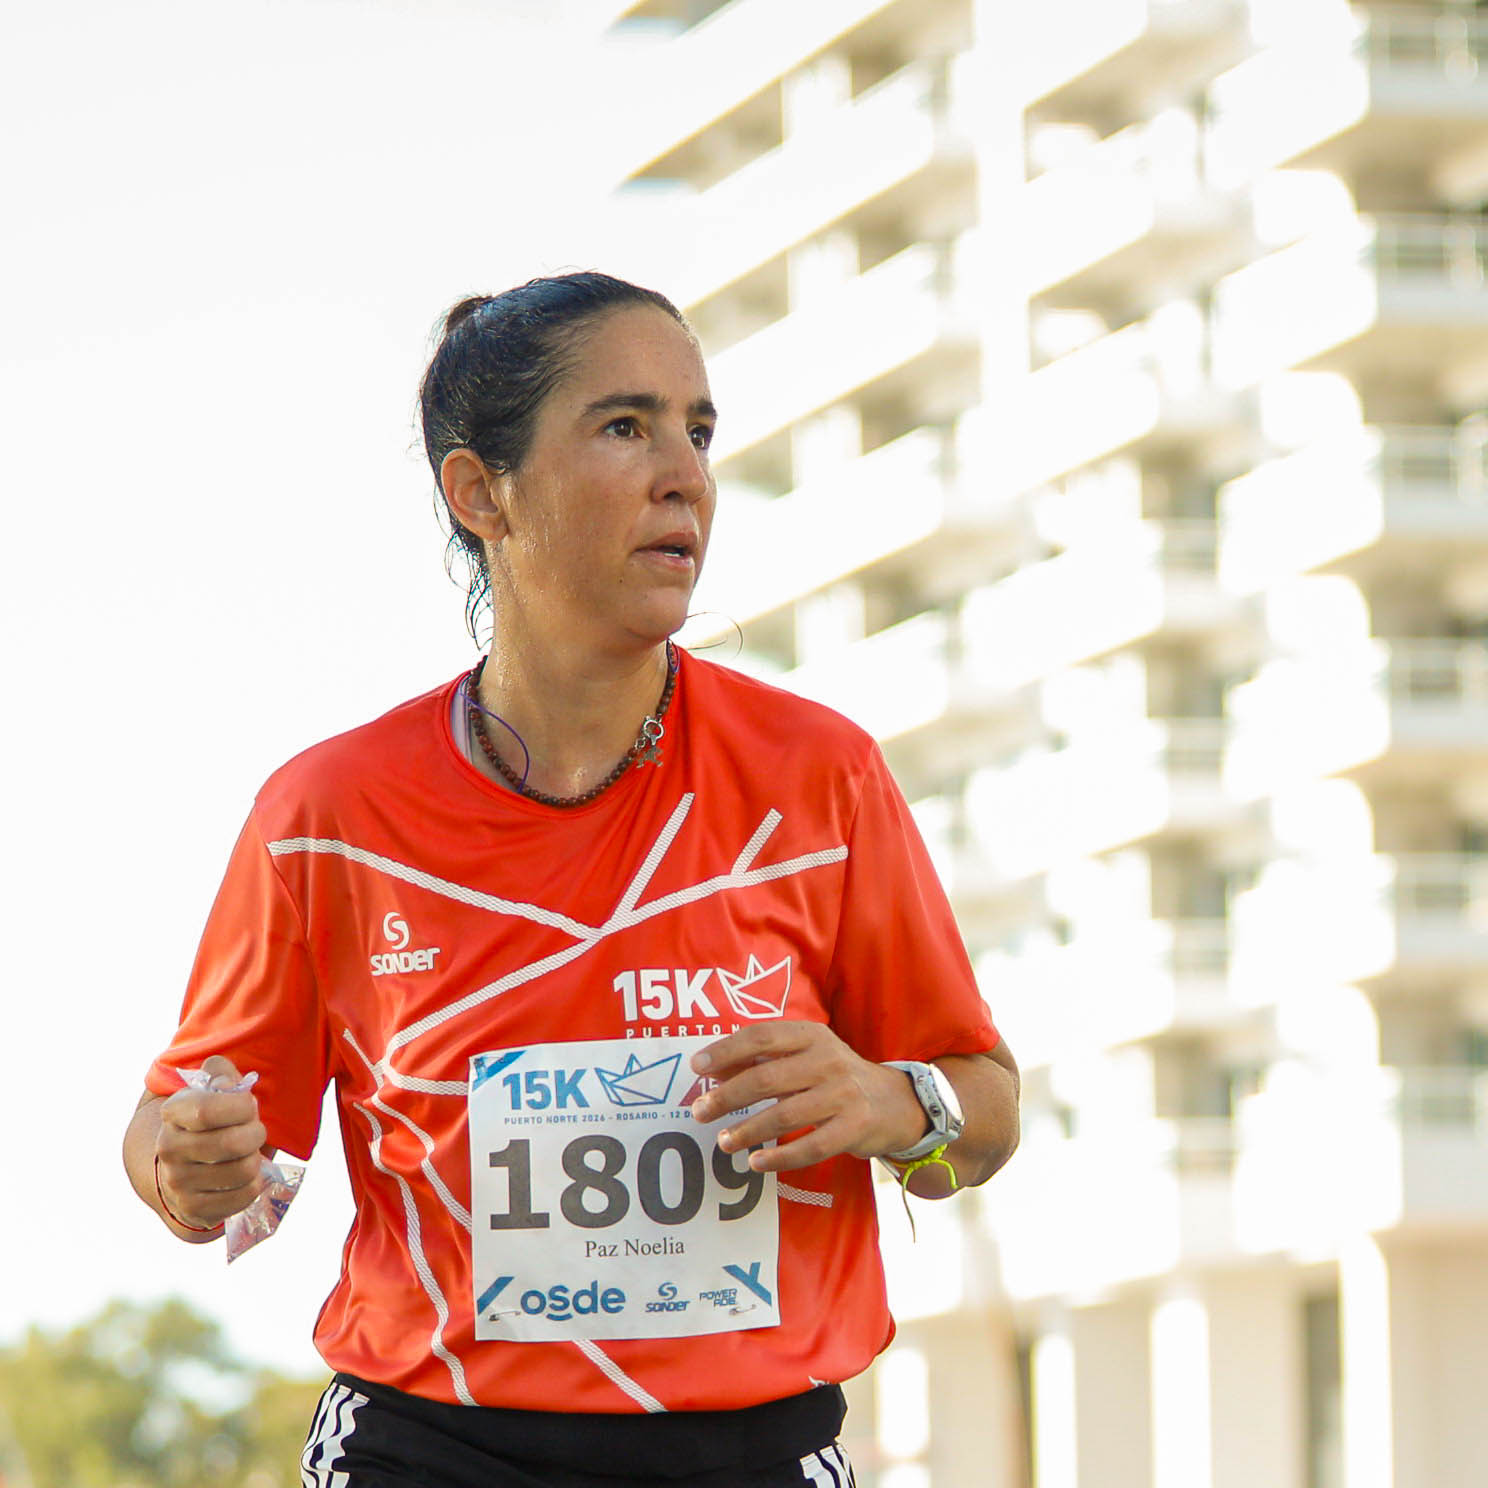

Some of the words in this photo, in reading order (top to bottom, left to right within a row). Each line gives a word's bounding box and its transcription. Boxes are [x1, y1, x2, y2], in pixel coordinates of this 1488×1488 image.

[613, 968, 720, 1021] 15K
[626, 1024, 721, 1039] PUERTO
[502, 1068, 590, 1111] 15K
[504, 1116, 542, 1125] PUERTO
[546, 1114, 577, 1124] NORTE
[616, 1111, 658, 1121] ROSARIO
[670, 1111, 681, 1119] 12
[489, 1131, 765, 1230] 1809
[585, 1240, 618, 1257] Paz
[625, 1236, 685, 1257] Noelia
[520, 1280, 626, 1315] osde
[699, 1288, 737, 1301] POWER
